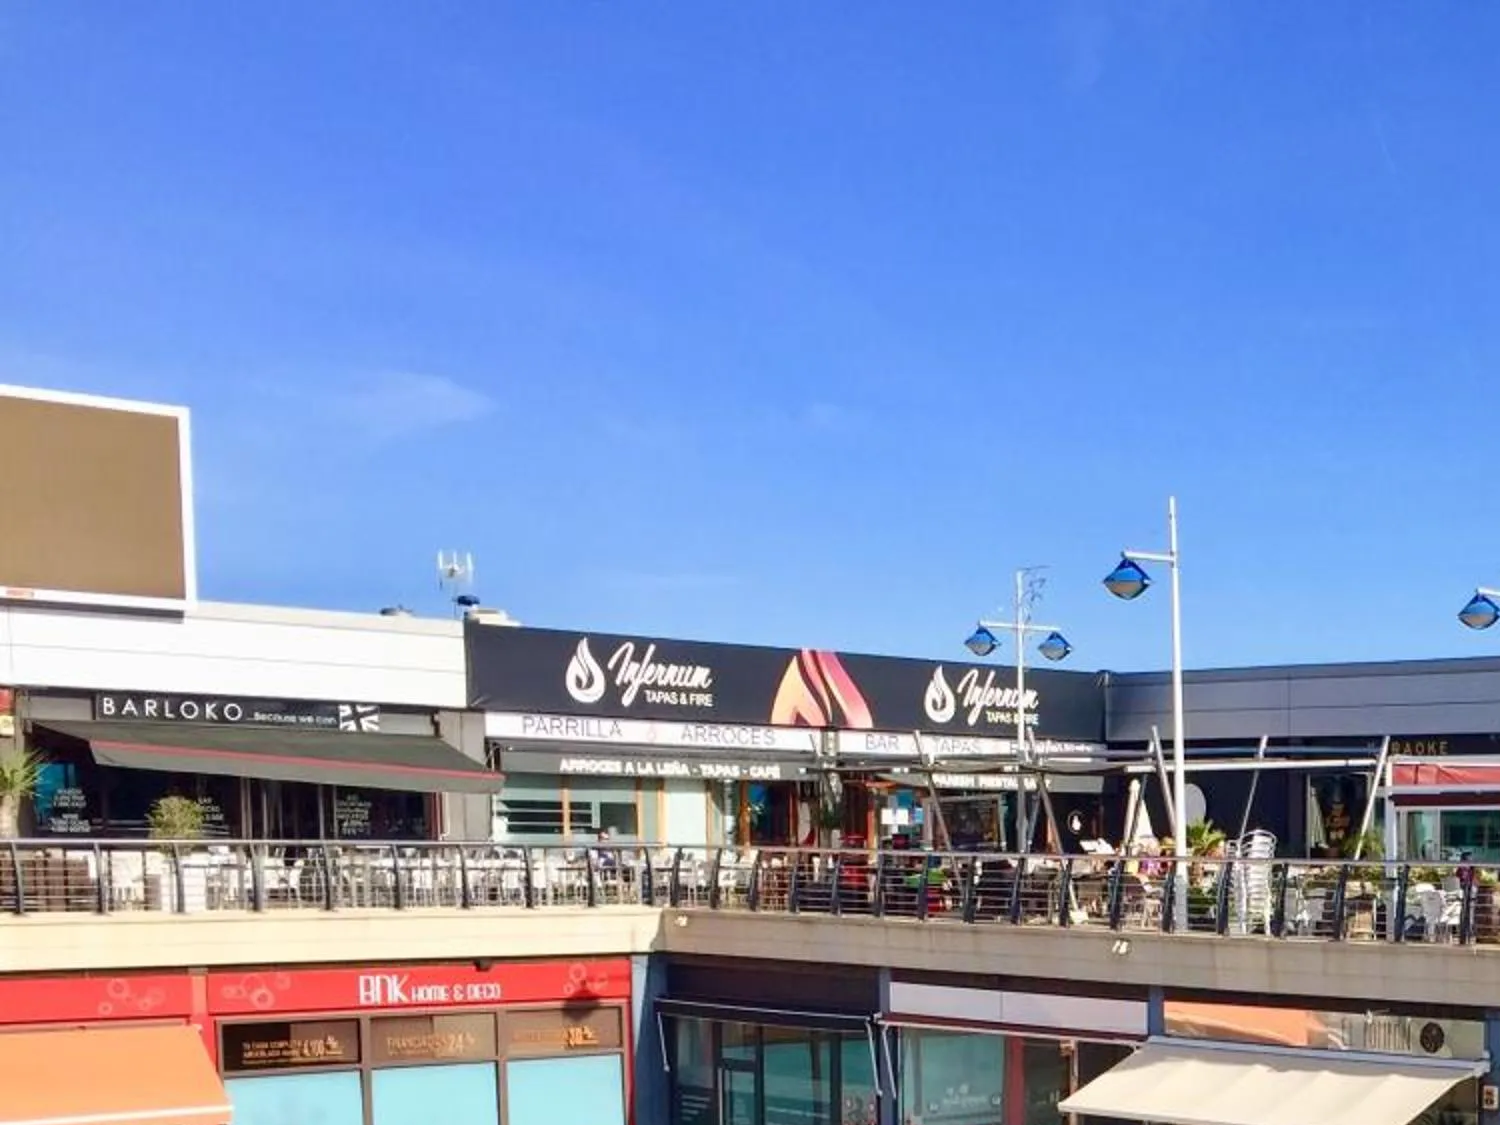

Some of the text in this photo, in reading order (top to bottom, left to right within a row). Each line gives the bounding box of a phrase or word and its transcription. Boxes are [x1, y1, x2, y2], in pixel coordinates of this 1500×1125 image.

[607, 641, 713, 707] Infernum
[645, 690, 679, 705] TAPAS
[690, 693, 713, 707] FIRE
[102, 697, 243, 721] BARLOKO
[986, 710, 1011, 723] TAPAS
[522, 715, 776, 746] PARRILLA ARROCES
[865, 734, 899, 750] BAR
[1367, 740, 1448, 755] KRAOKE
[637, 761, 655, 775] LA
[453, 983, 464, 1000] &
